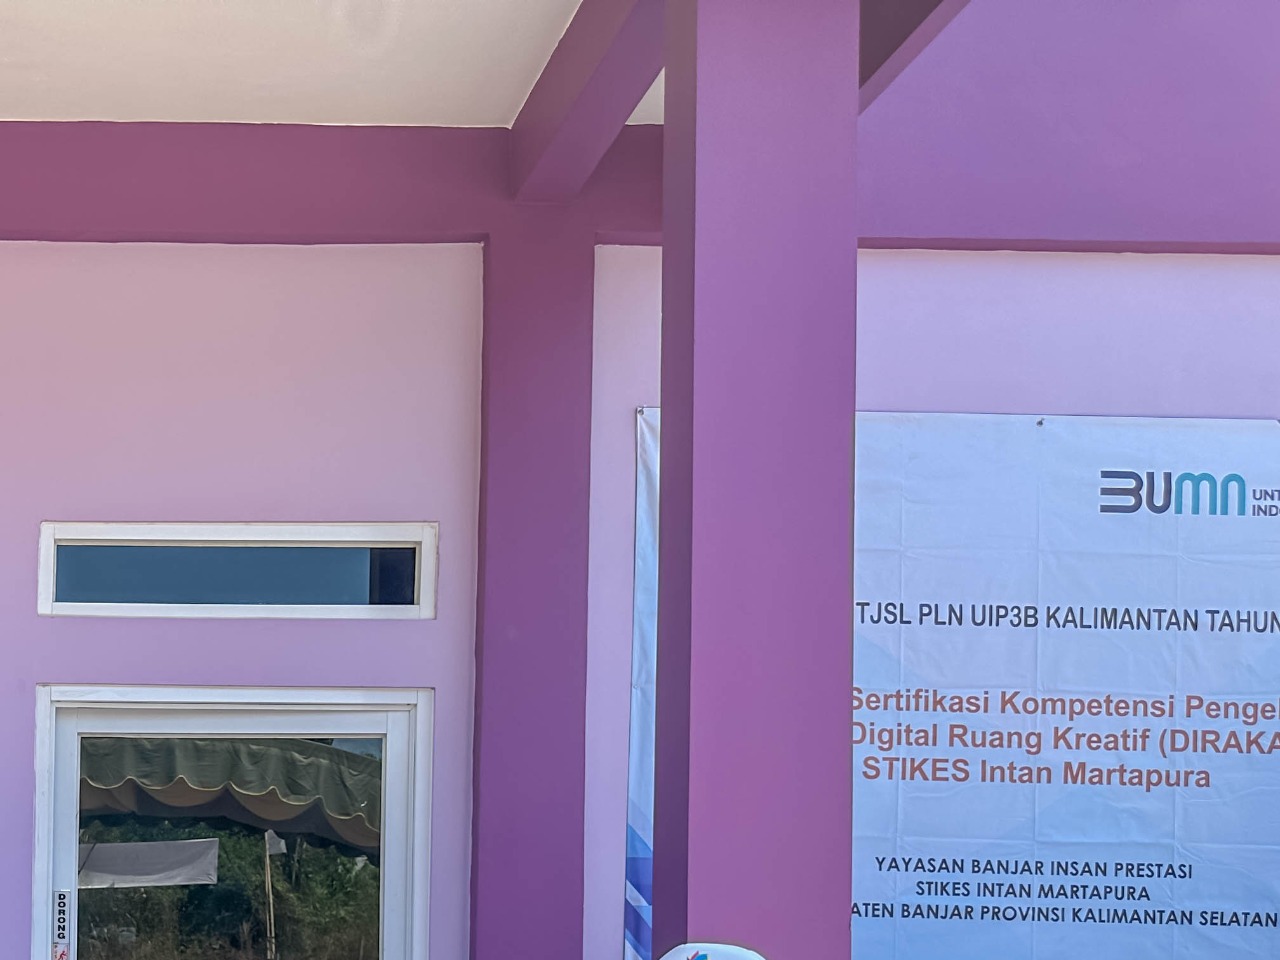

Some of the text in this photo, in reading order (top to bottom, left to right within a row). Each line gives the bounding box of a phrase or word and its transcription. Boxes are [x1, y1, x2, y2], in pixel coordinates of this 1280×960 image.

[1100, 471, 1246, 516] BUMN
[1252, 504, 1280, 516] IND
[856, 602, 911, 624] TJSL
[919, 603, 963, 626] PLN
[971, 604, 1039, 628] UIP3B
[1046, 606, 1199, 632] KALIMANTAN
[853, 687, 989, 713] Sertifikasi
[1000, 691, 1174, 721] Kompetensi
[853, 721, 937, 752] Digital
[949, 724, 1041, 756] Ruang
[1053, 726, 1150, 752] Kreatif
[862, 756, 1211, 792] STIKES Intan Martapura
[875, 857, 1192, 879] YAYASAN BANJAR INSAN PRESTASI
[915, 881, 1151, 901] STIKES INTAN MARTAPURA
[57, 893, 66, 939] DORONG
[901, 904, 974, 920] BANJAR
[980, 906, 1065, 922] PROVINSI
[1072, 907, 1193, 925] KALIMANTAN
[1199, 910, 1278, 928] SELATAN
